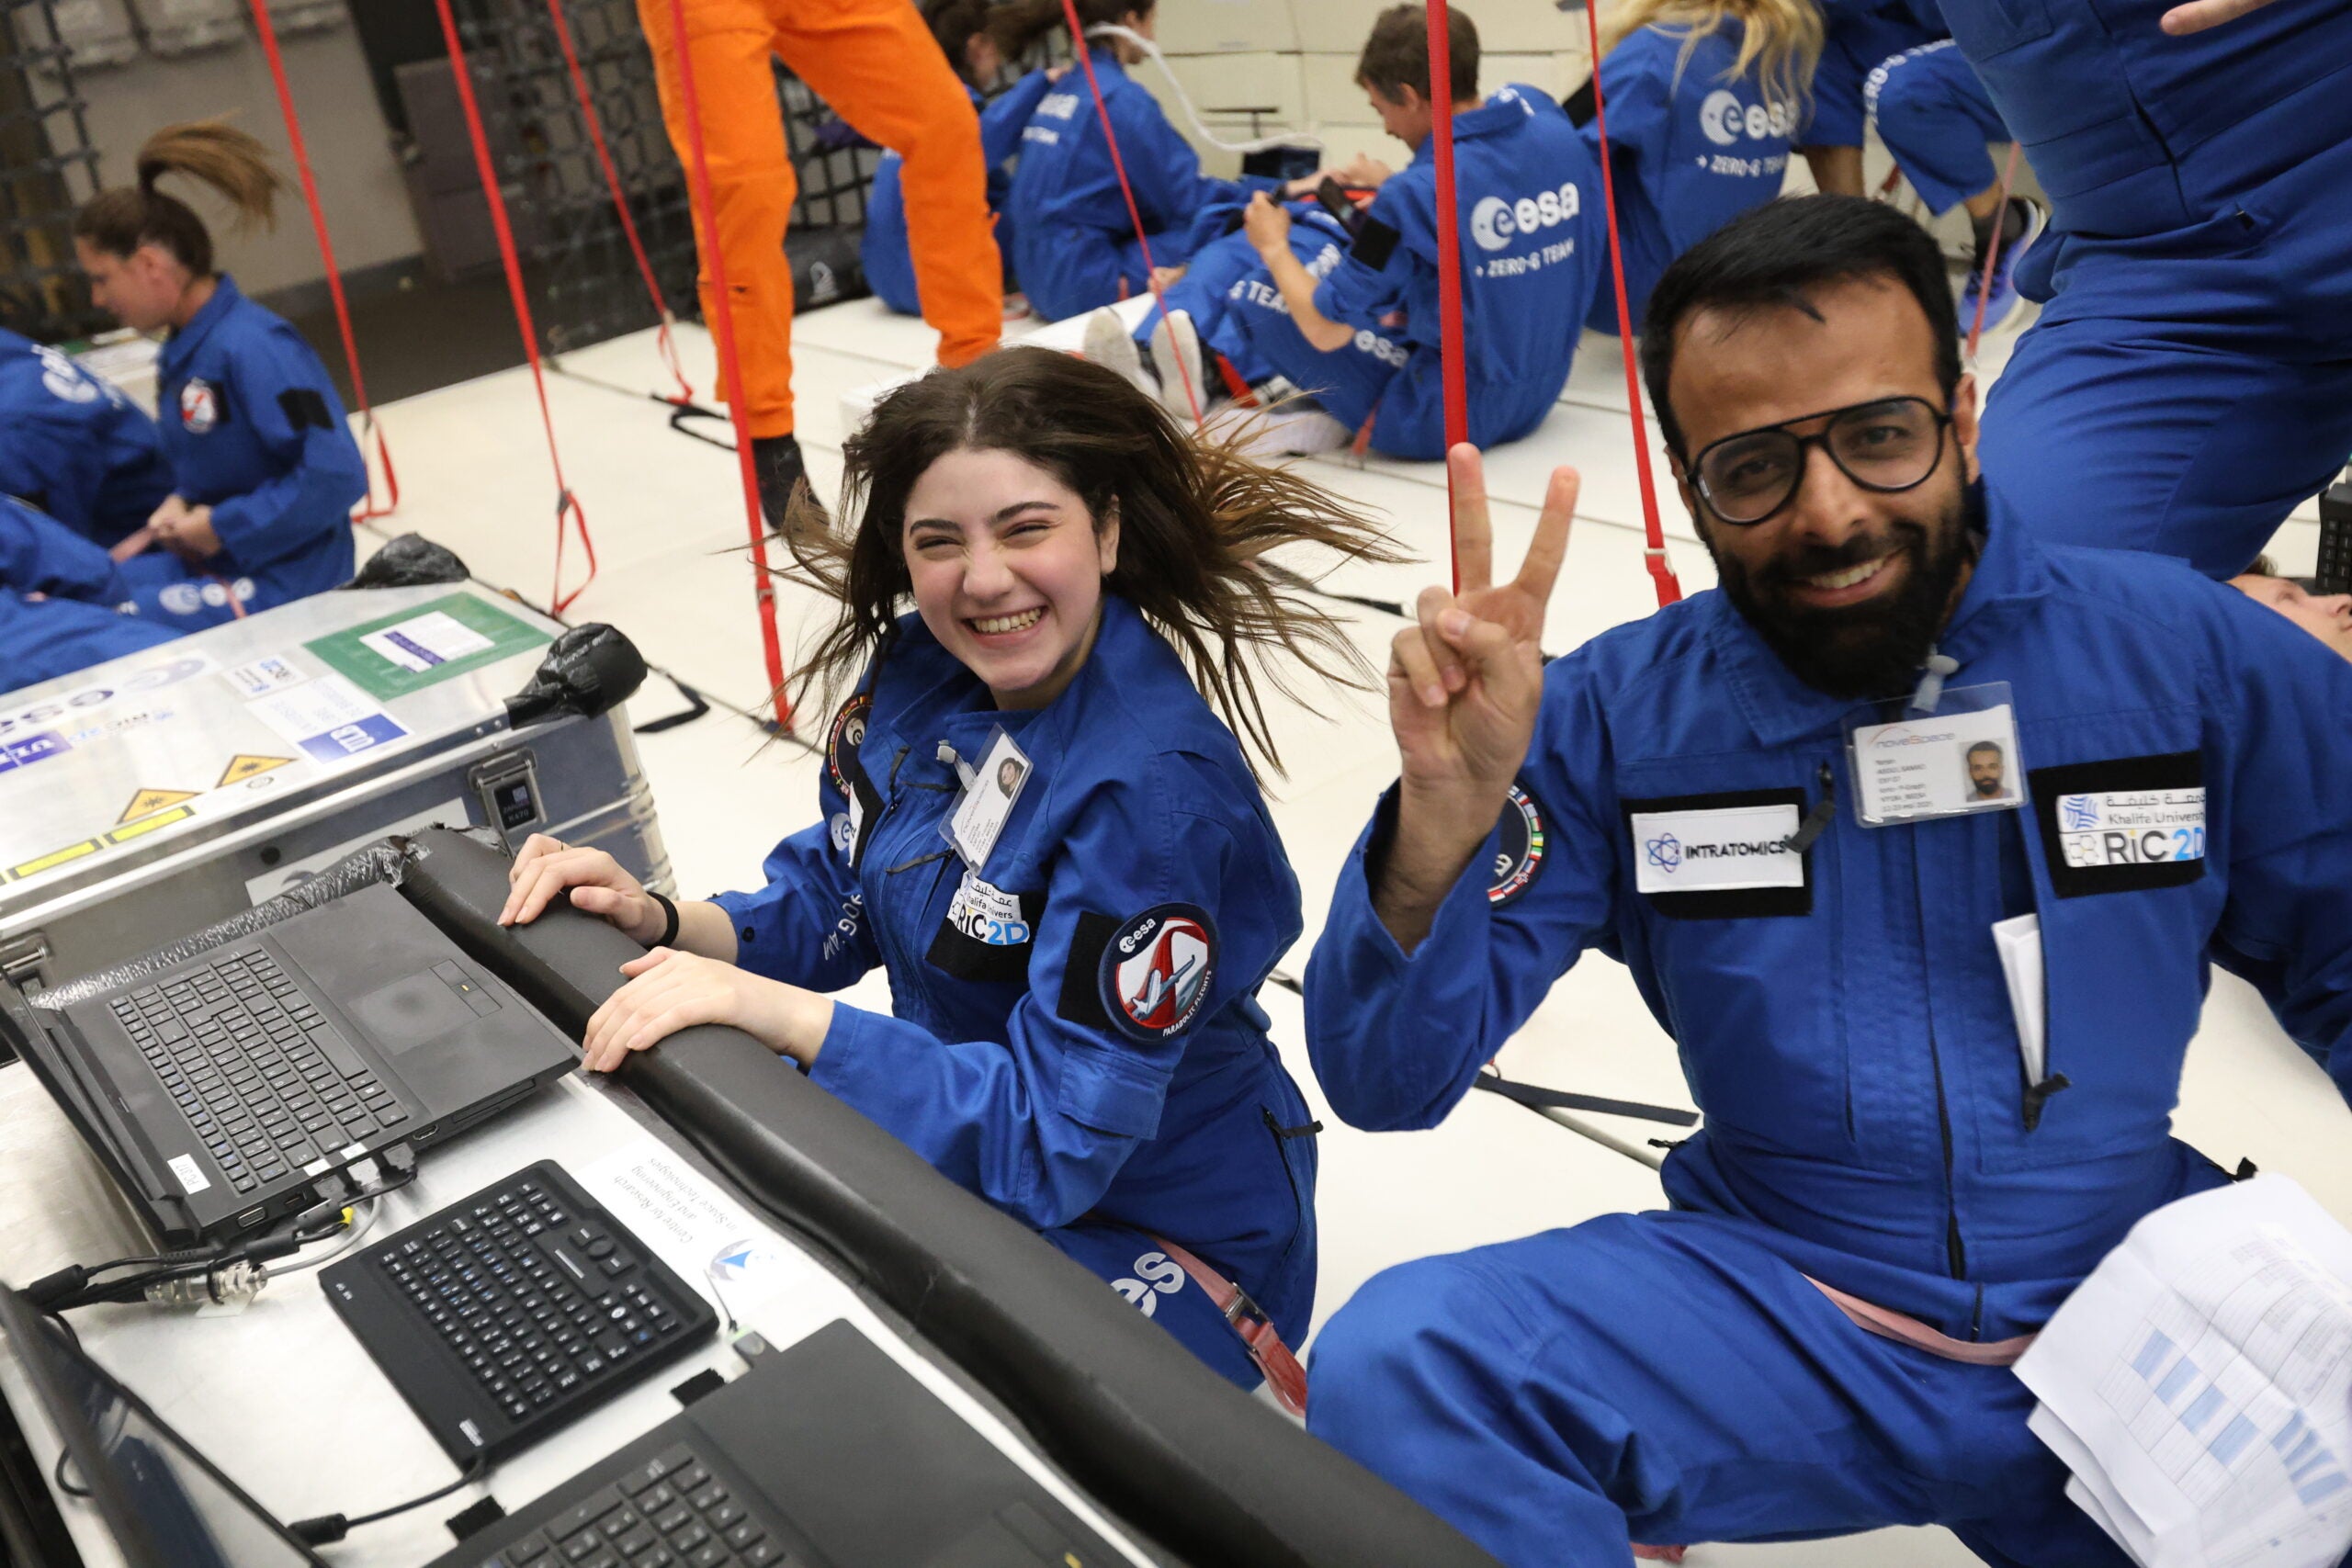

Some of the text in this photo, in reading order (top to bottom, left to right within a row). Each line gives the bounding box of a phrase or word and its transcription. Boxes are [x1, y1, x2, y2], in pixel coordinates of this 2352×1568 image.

[1514, 182, 1579, 233] esa
[1487, 256, 1542, 277] ZERO-G
[1354, 329, 1410, 367] esa
[2109, 811, 2205, 826] Khalifa Universit
[1685, 840, 1787, 860] INTRATOMICS
[1134, 919, 1157, 941] esa
[1162, 969, 1213, 1037] PARABOLIC FLIGHTS
[631, 1164, 698, 1220] and Engineering
[647, 1156, 700, 1202] Technologies
[613, 1175, 694, 1243] Centre for Research
[698, 1199, 729, 1224] Space
